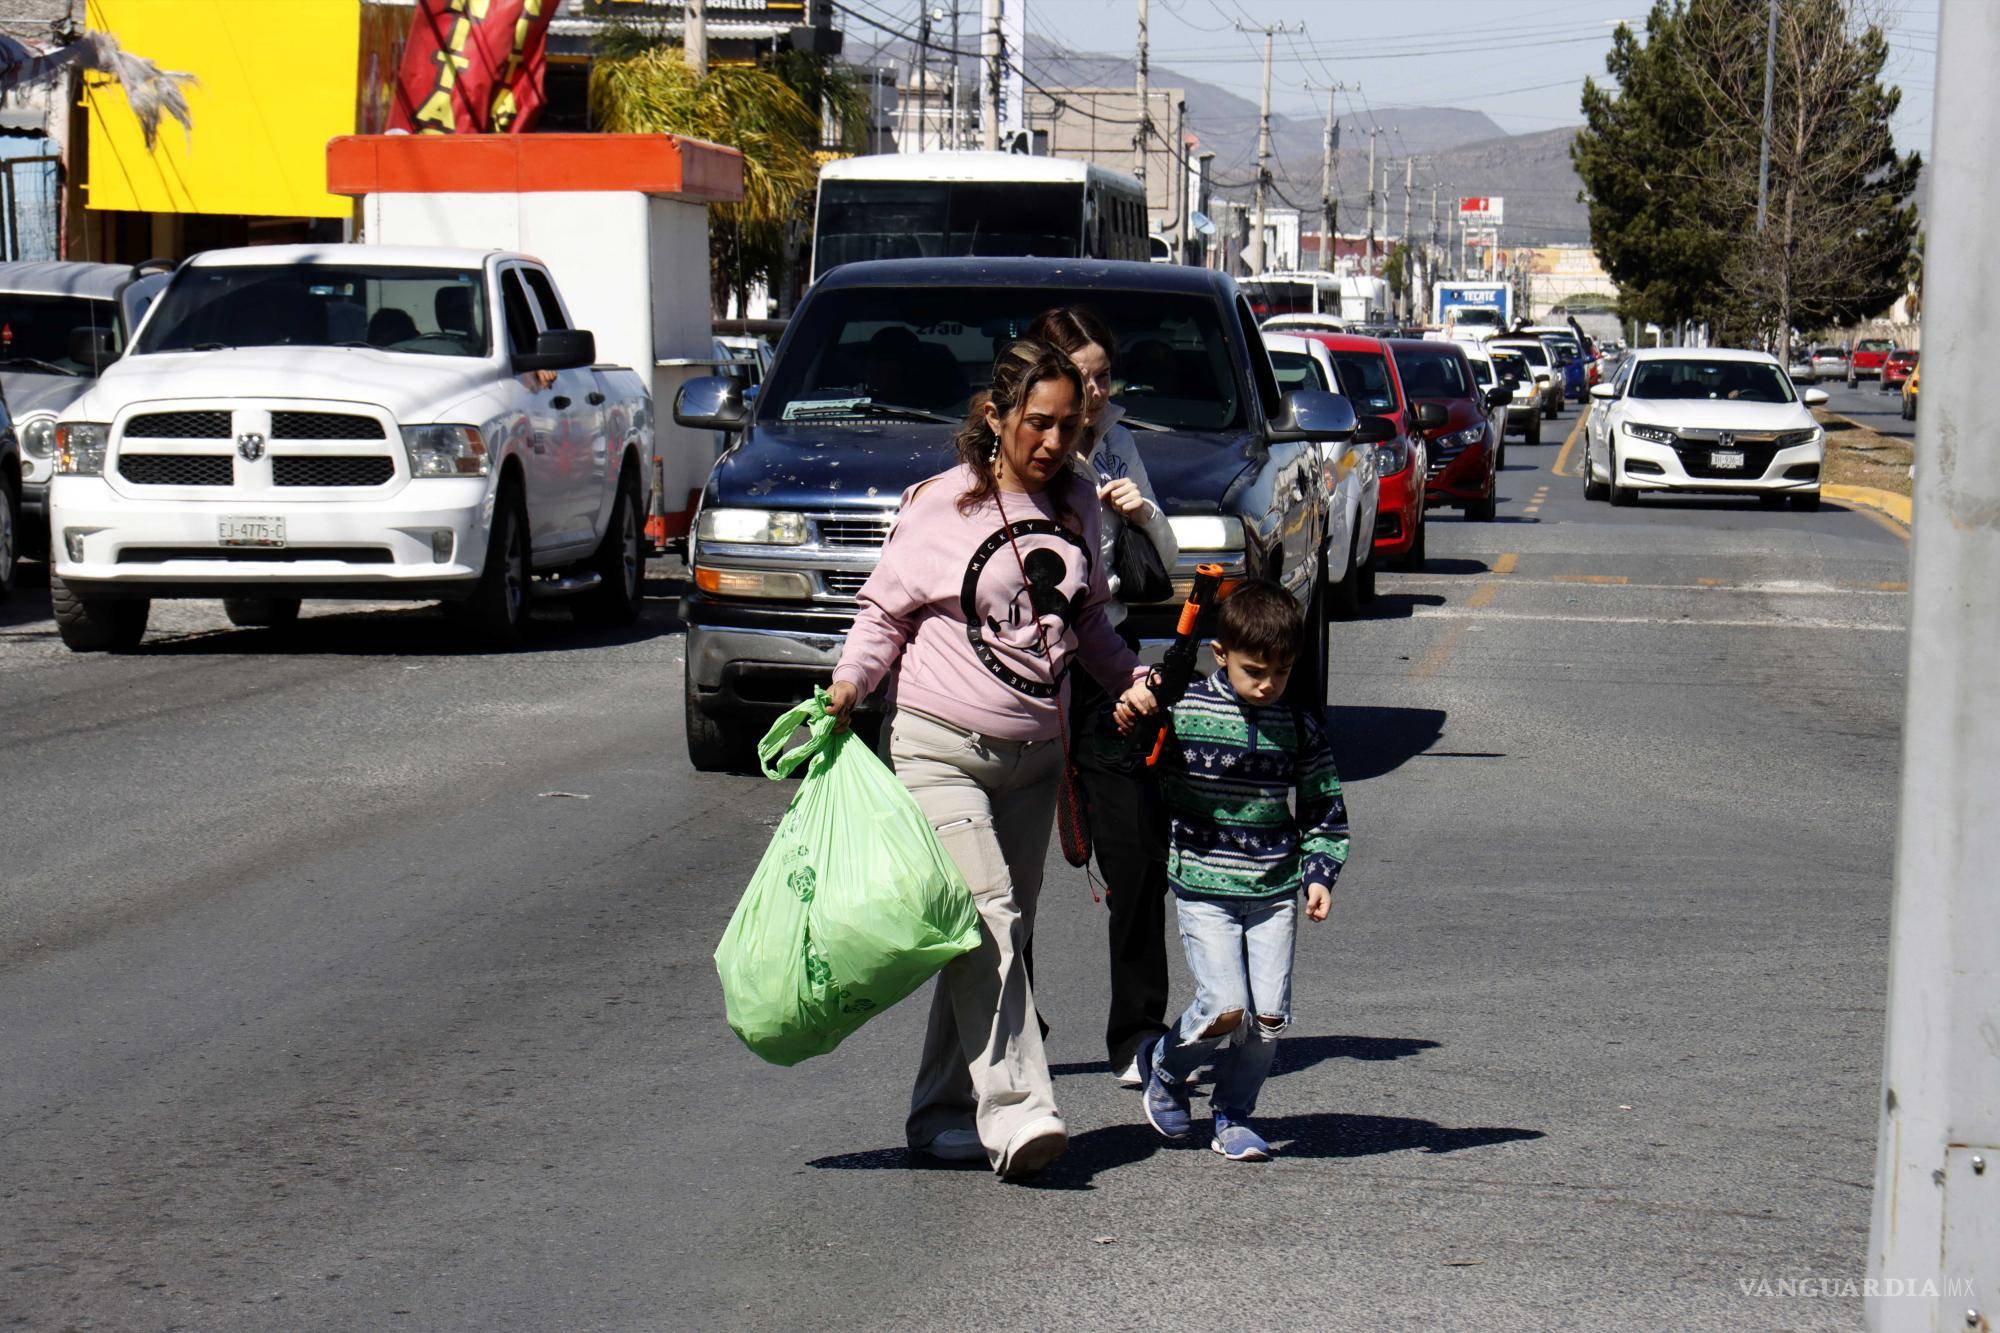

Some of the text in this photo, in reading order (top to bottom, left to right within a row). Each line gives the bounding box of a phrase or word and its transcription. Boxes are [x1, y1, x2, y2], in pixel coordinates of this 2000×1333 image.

[1463, 291, 1496, 302] TECATE
[219, 523, 283, 538] EJ-4775-C
[971, 522, 1034, 572] MICKEY
[1010, 677, 1036, 694] THE
